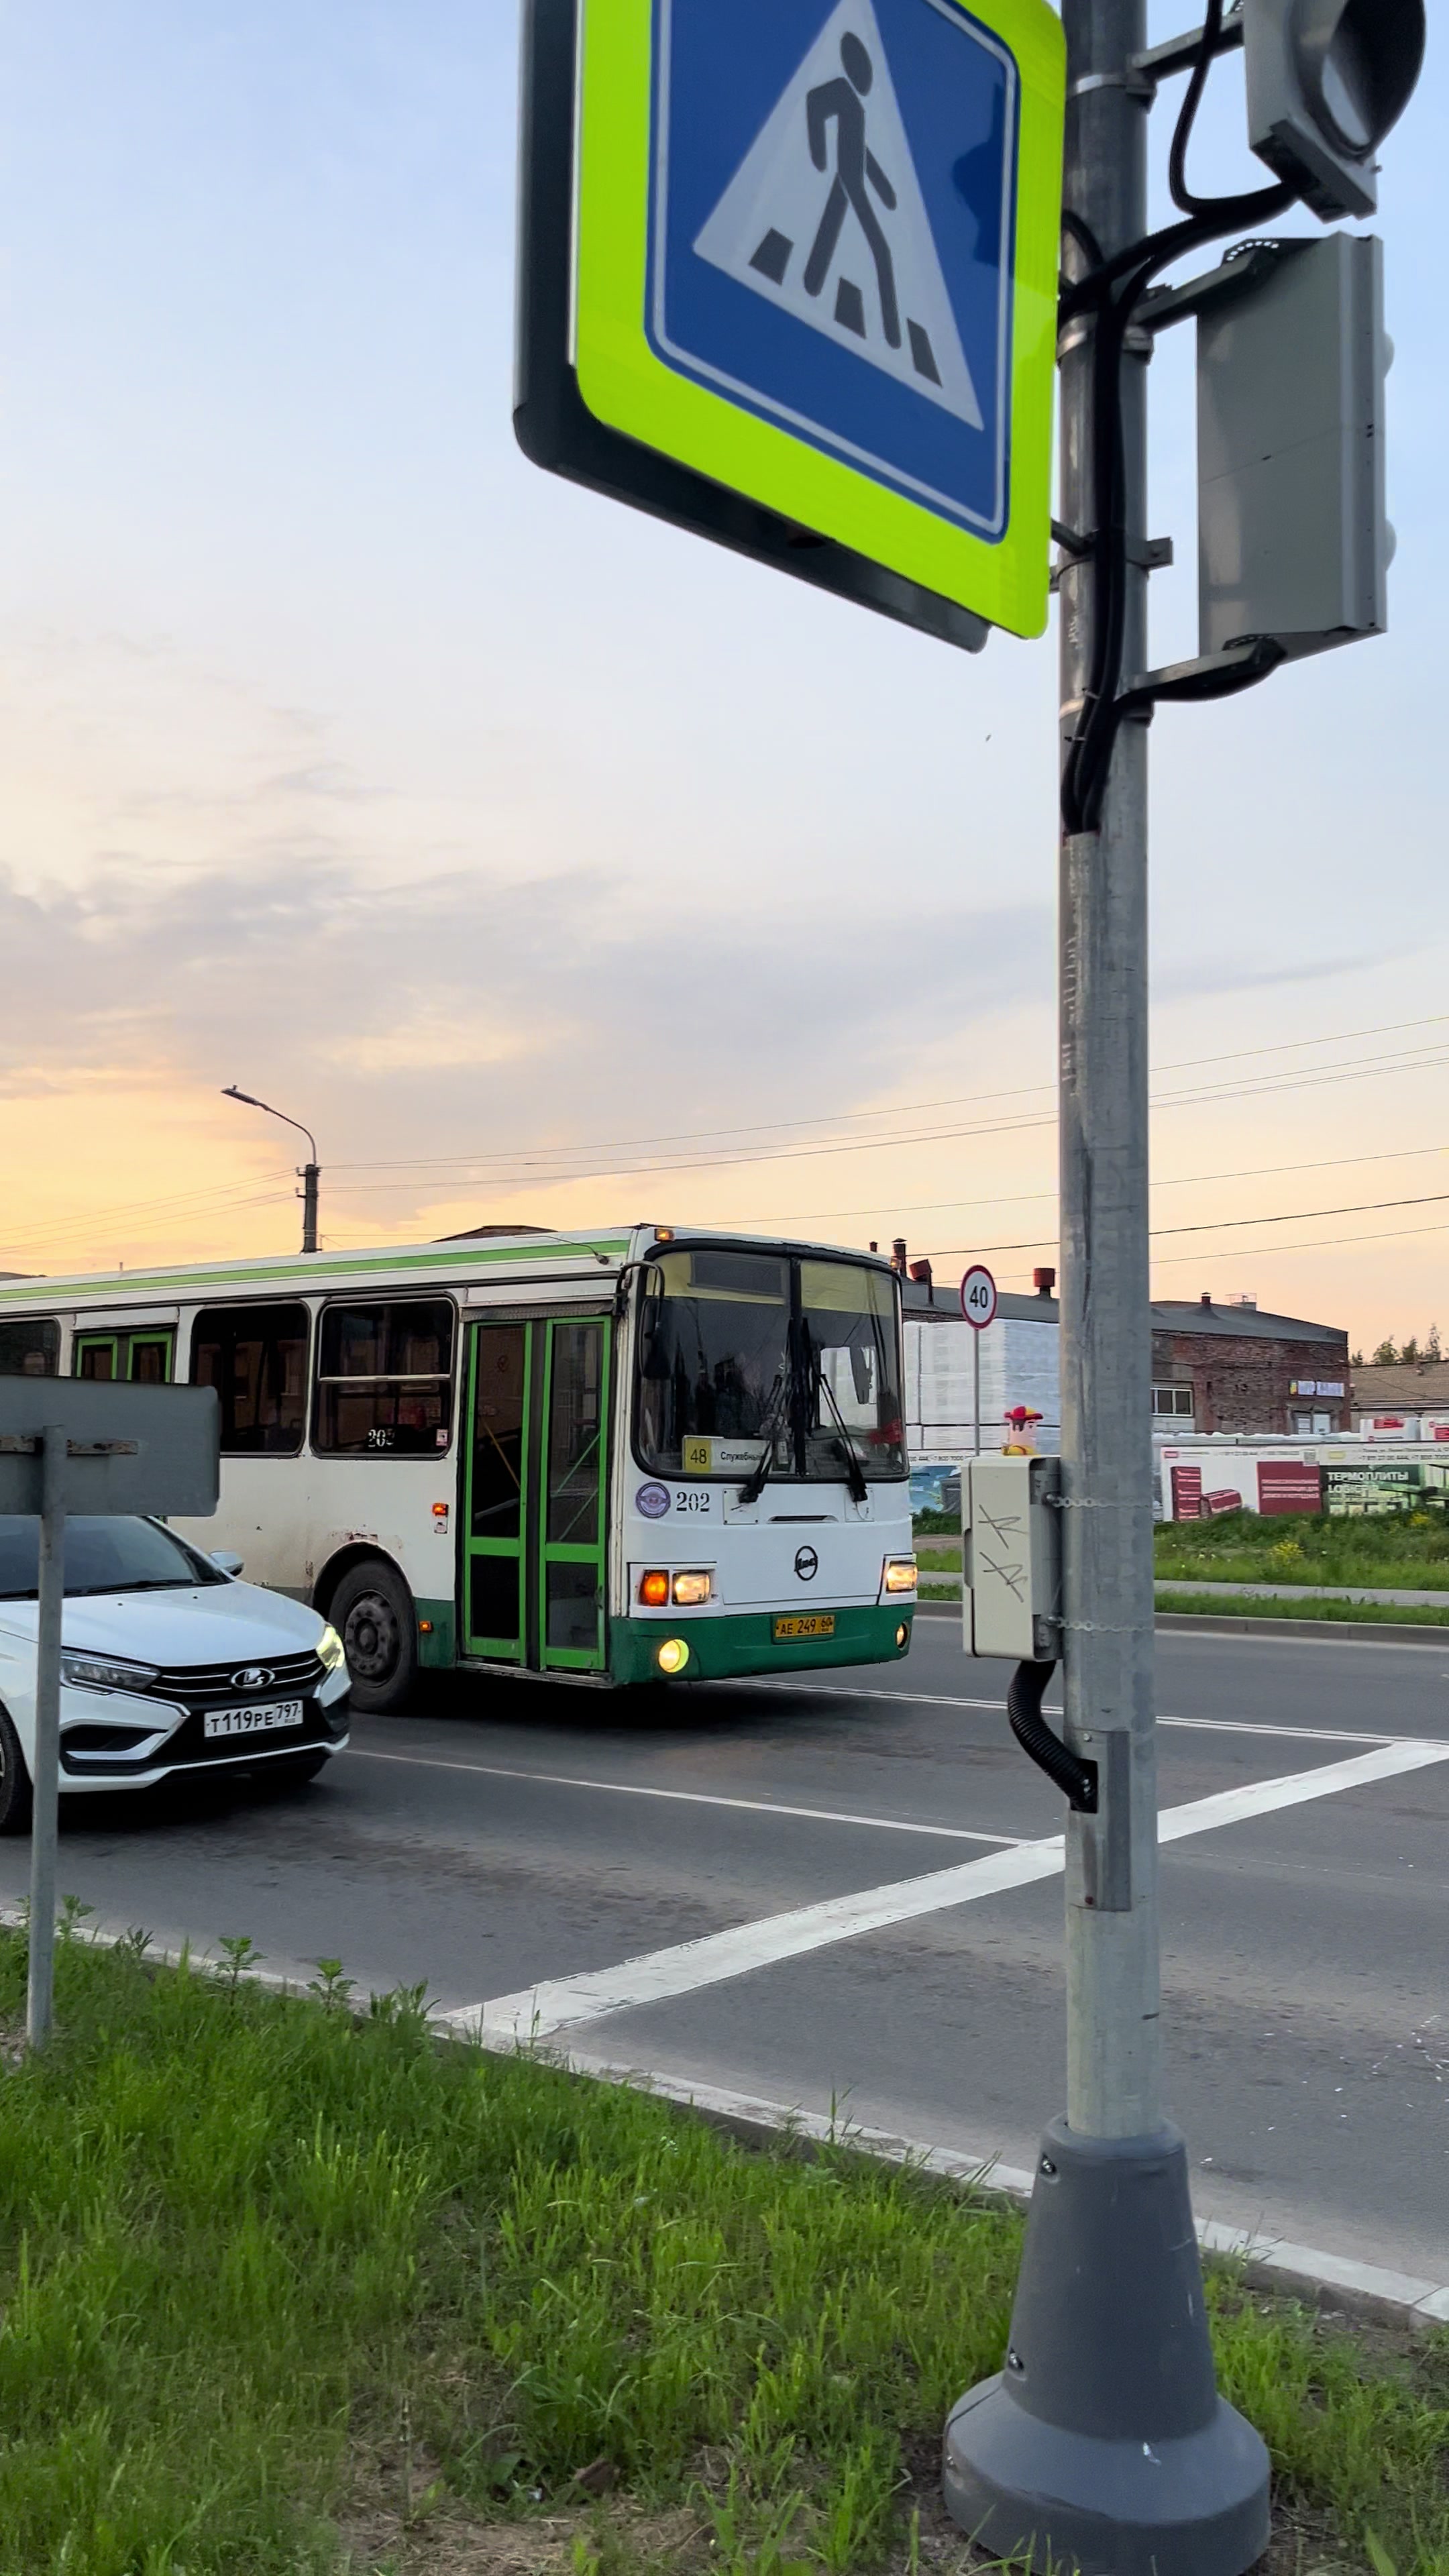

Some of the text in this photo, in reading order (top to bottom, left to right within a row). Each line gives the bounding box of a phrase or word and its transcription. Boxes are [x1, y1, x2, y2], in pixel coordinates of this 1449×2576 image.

[969, 1285, 988, 1308] 40
[690, 1448, 707, 1464] 48
[1327, 1472, 1409, 1481] ТЕРМОПЛИТЫ
[676, 1491, 710, 1512] 202
[798, 1618, 816, 1633] 249
[211, 1703, 299, 1732] Т119РЕ 797
